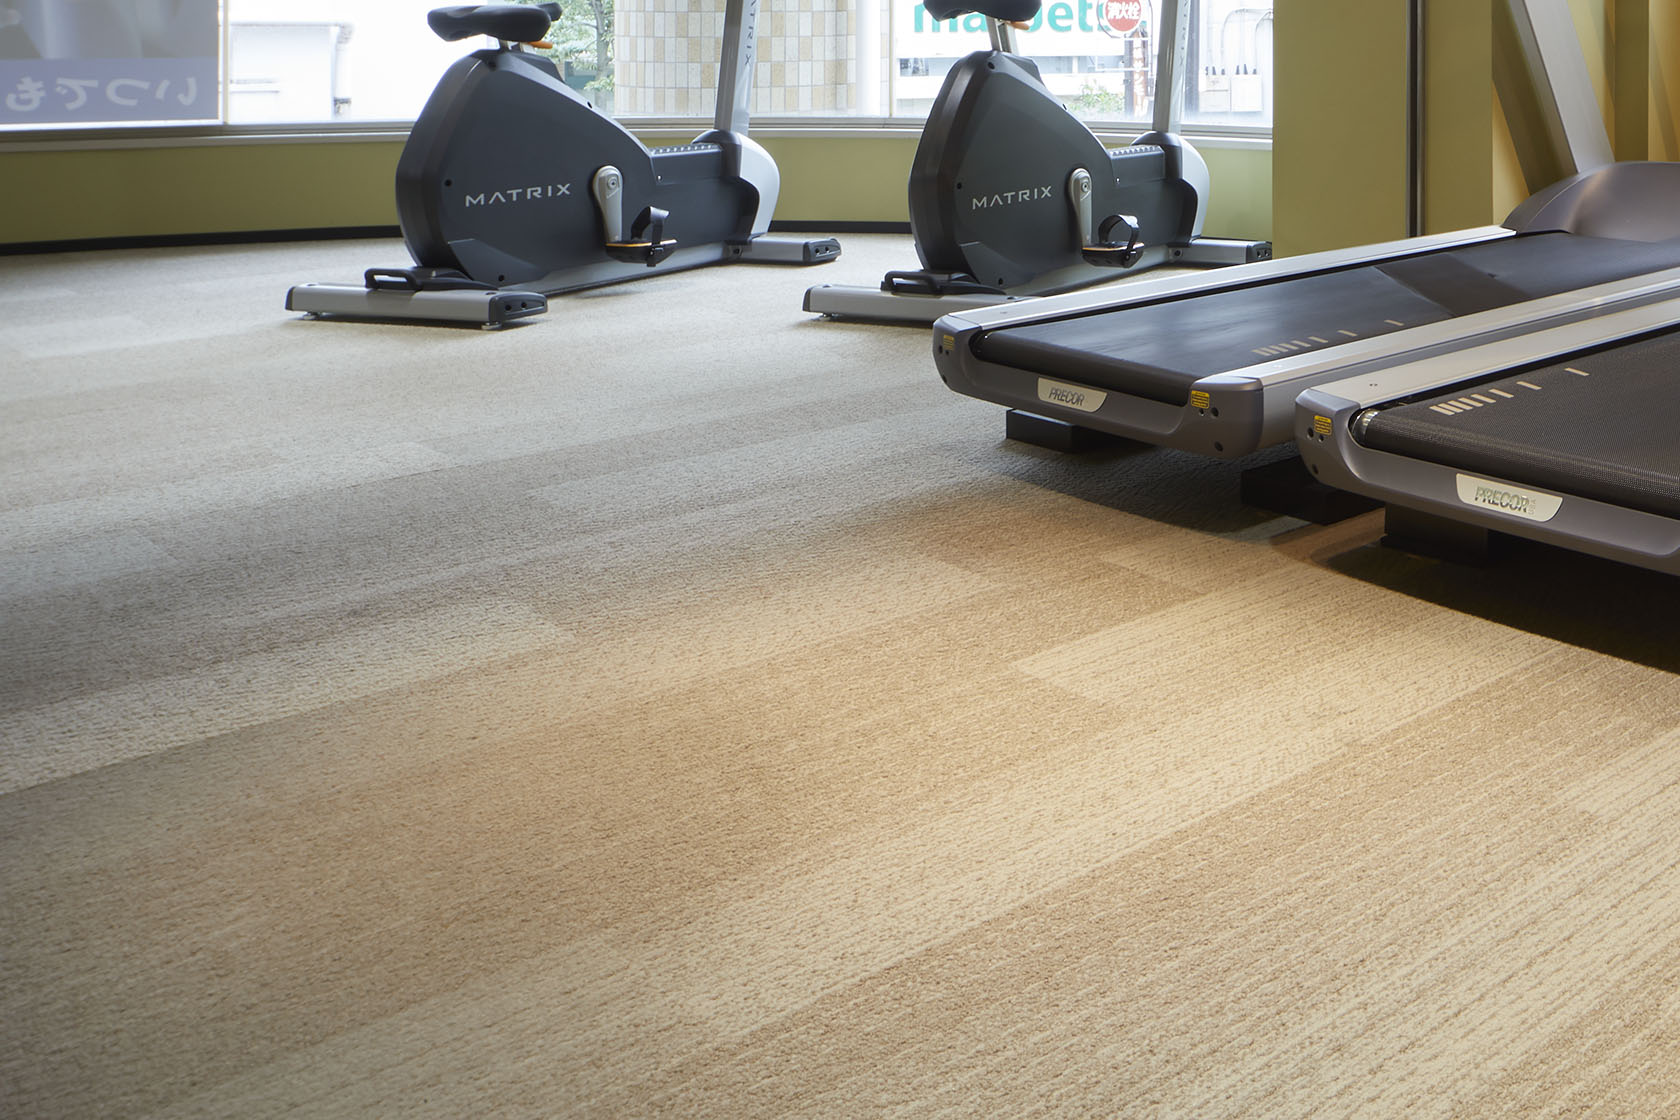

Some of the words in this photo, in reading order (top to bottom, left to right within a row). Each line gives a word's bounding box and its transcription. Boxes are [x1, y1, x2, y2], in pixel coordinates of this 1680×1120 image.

[1106, 1, 1141, 21] 消火栓
[465, 183, 571, 208] MATRIX
[972, 185, 1053, 210] MATRIX
[1048, 387, 1085, 406] PRECOR
[1474, 486, 1529, 512] PRECOR
